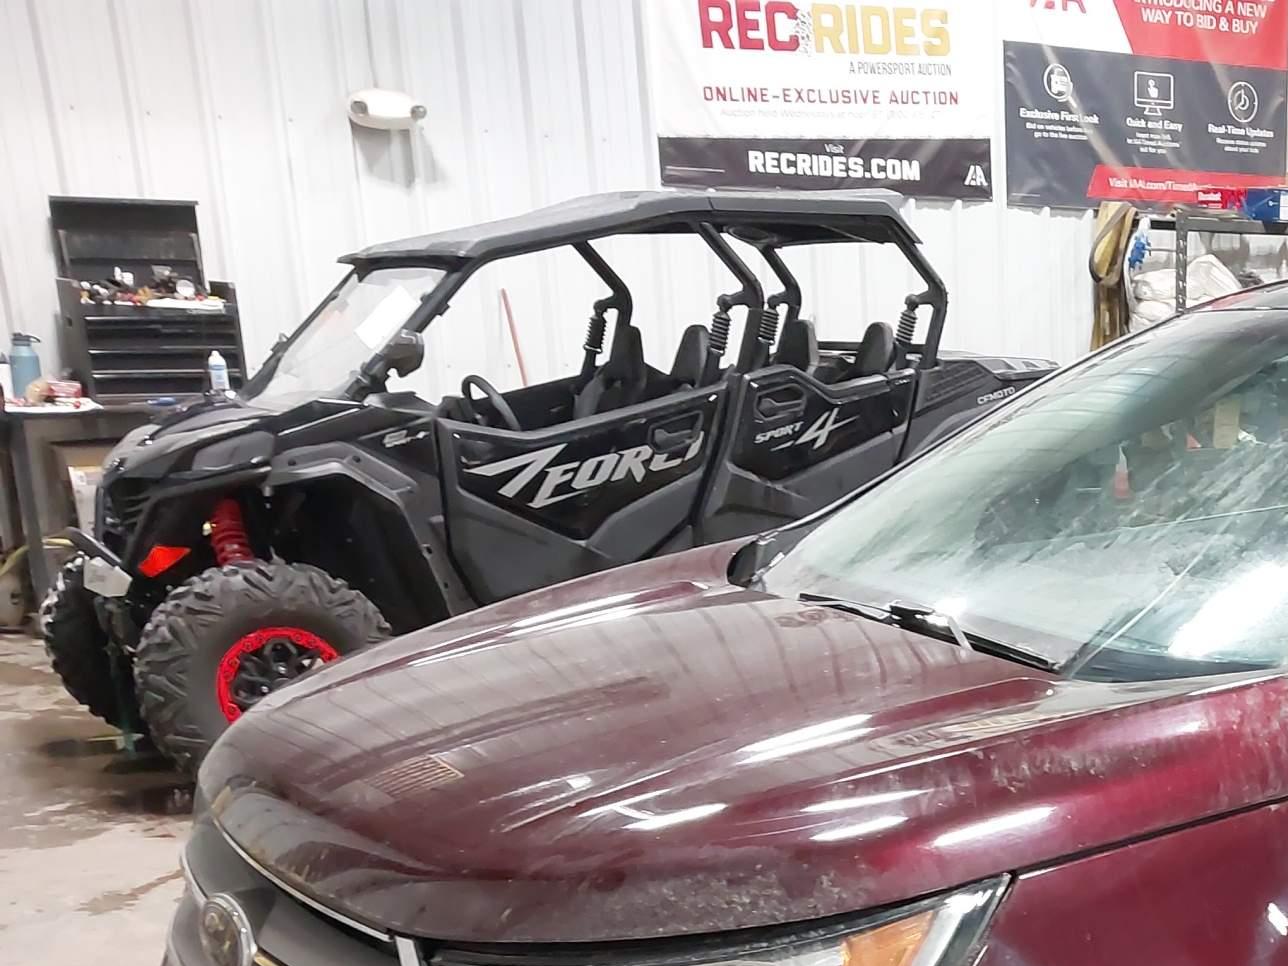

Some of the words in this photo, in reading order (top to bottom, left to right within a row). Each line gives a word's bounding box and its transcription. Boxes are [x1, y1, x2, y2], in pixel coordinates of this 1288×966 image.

[1132, 0, 1222, 13] ODUCING
[1224, 0, 1235, 15] A
[1237, 2, 1268, 18] NEW
[1141, 7, 1173, 25] WAY
[1175, 11, 1194, 27] TO
[1196, 14, 1217, 30] BID
[1219, 16, 1229, 32] &
[1231, 19, 1259, 34] BUY
[698, 0, 799, 51] REC
[811, 3, 950, 56] RIDES
[858, 62, 915, 76] POWERSPORT
[917, 63, 952, 76] AUCTION
[703, 86, 881, 104] ONLINE-EXCLUSIVE
[888, 90, 960, 105] AUCTION
[1126, 117, 1146, 128] Quick
[1147, 119, 1163, 129] and
[1164, 119, 1183, 132] Easy
[748, 150, 921, 181] RECRIDES.COM
[753, 421, 804, 444] SPORT
[794, 407, 860, 449] 4
[463, 431, 705, 508] ZFORC
